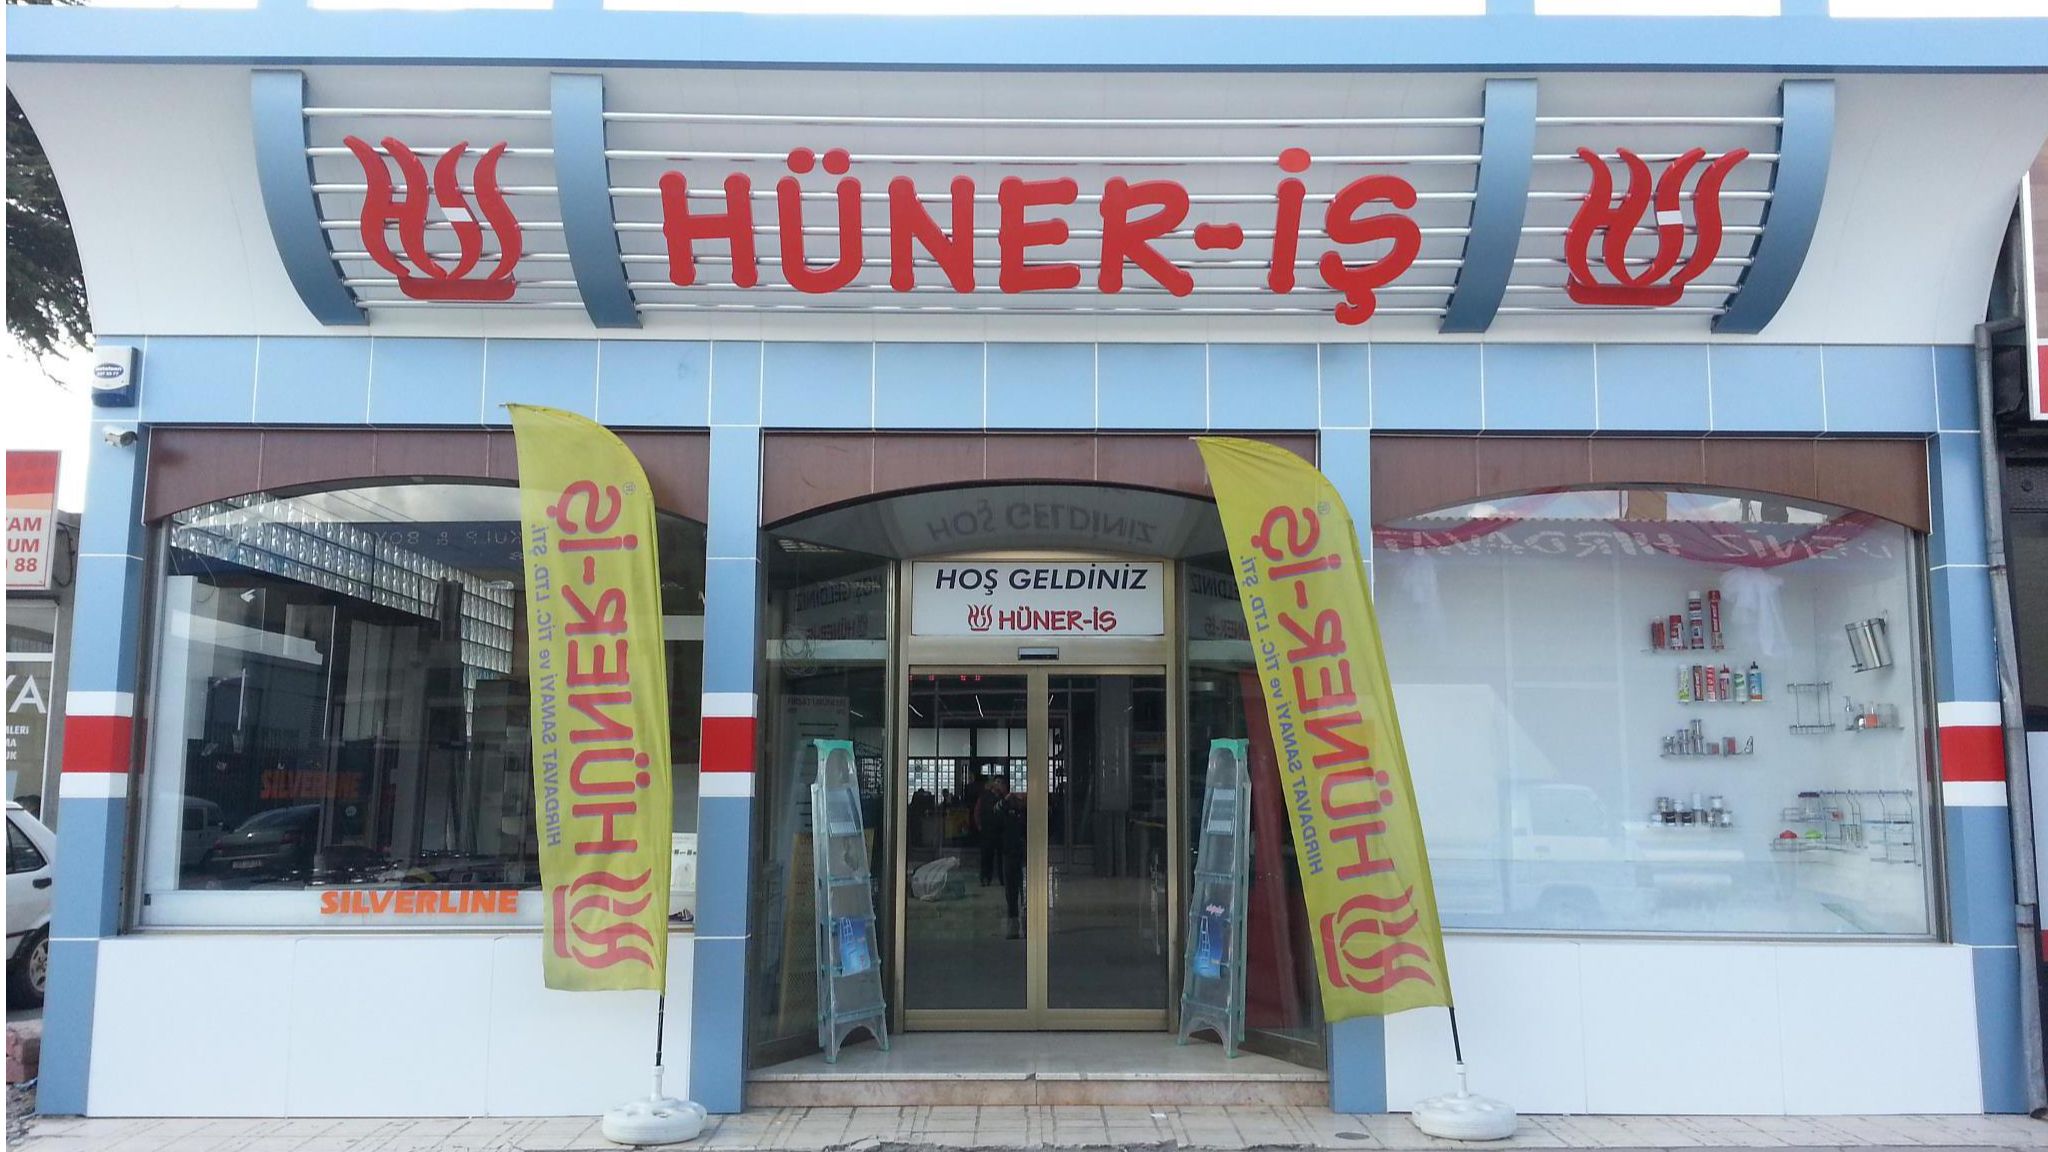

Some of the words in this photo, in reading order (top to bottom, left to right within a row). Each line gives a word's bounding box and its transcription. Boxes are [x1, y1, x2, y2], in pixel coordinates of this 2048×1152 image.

[661, 147, 1421, 325] HÜNER-İŞ
[936, 567, 998, 596] HOŞ
[1008, 563, 1148, 590] GELDİNİZ
[998, 606, 1118, 633] HÜNER-İŞ
[319, 890, 518, 915] SILVERLINE
